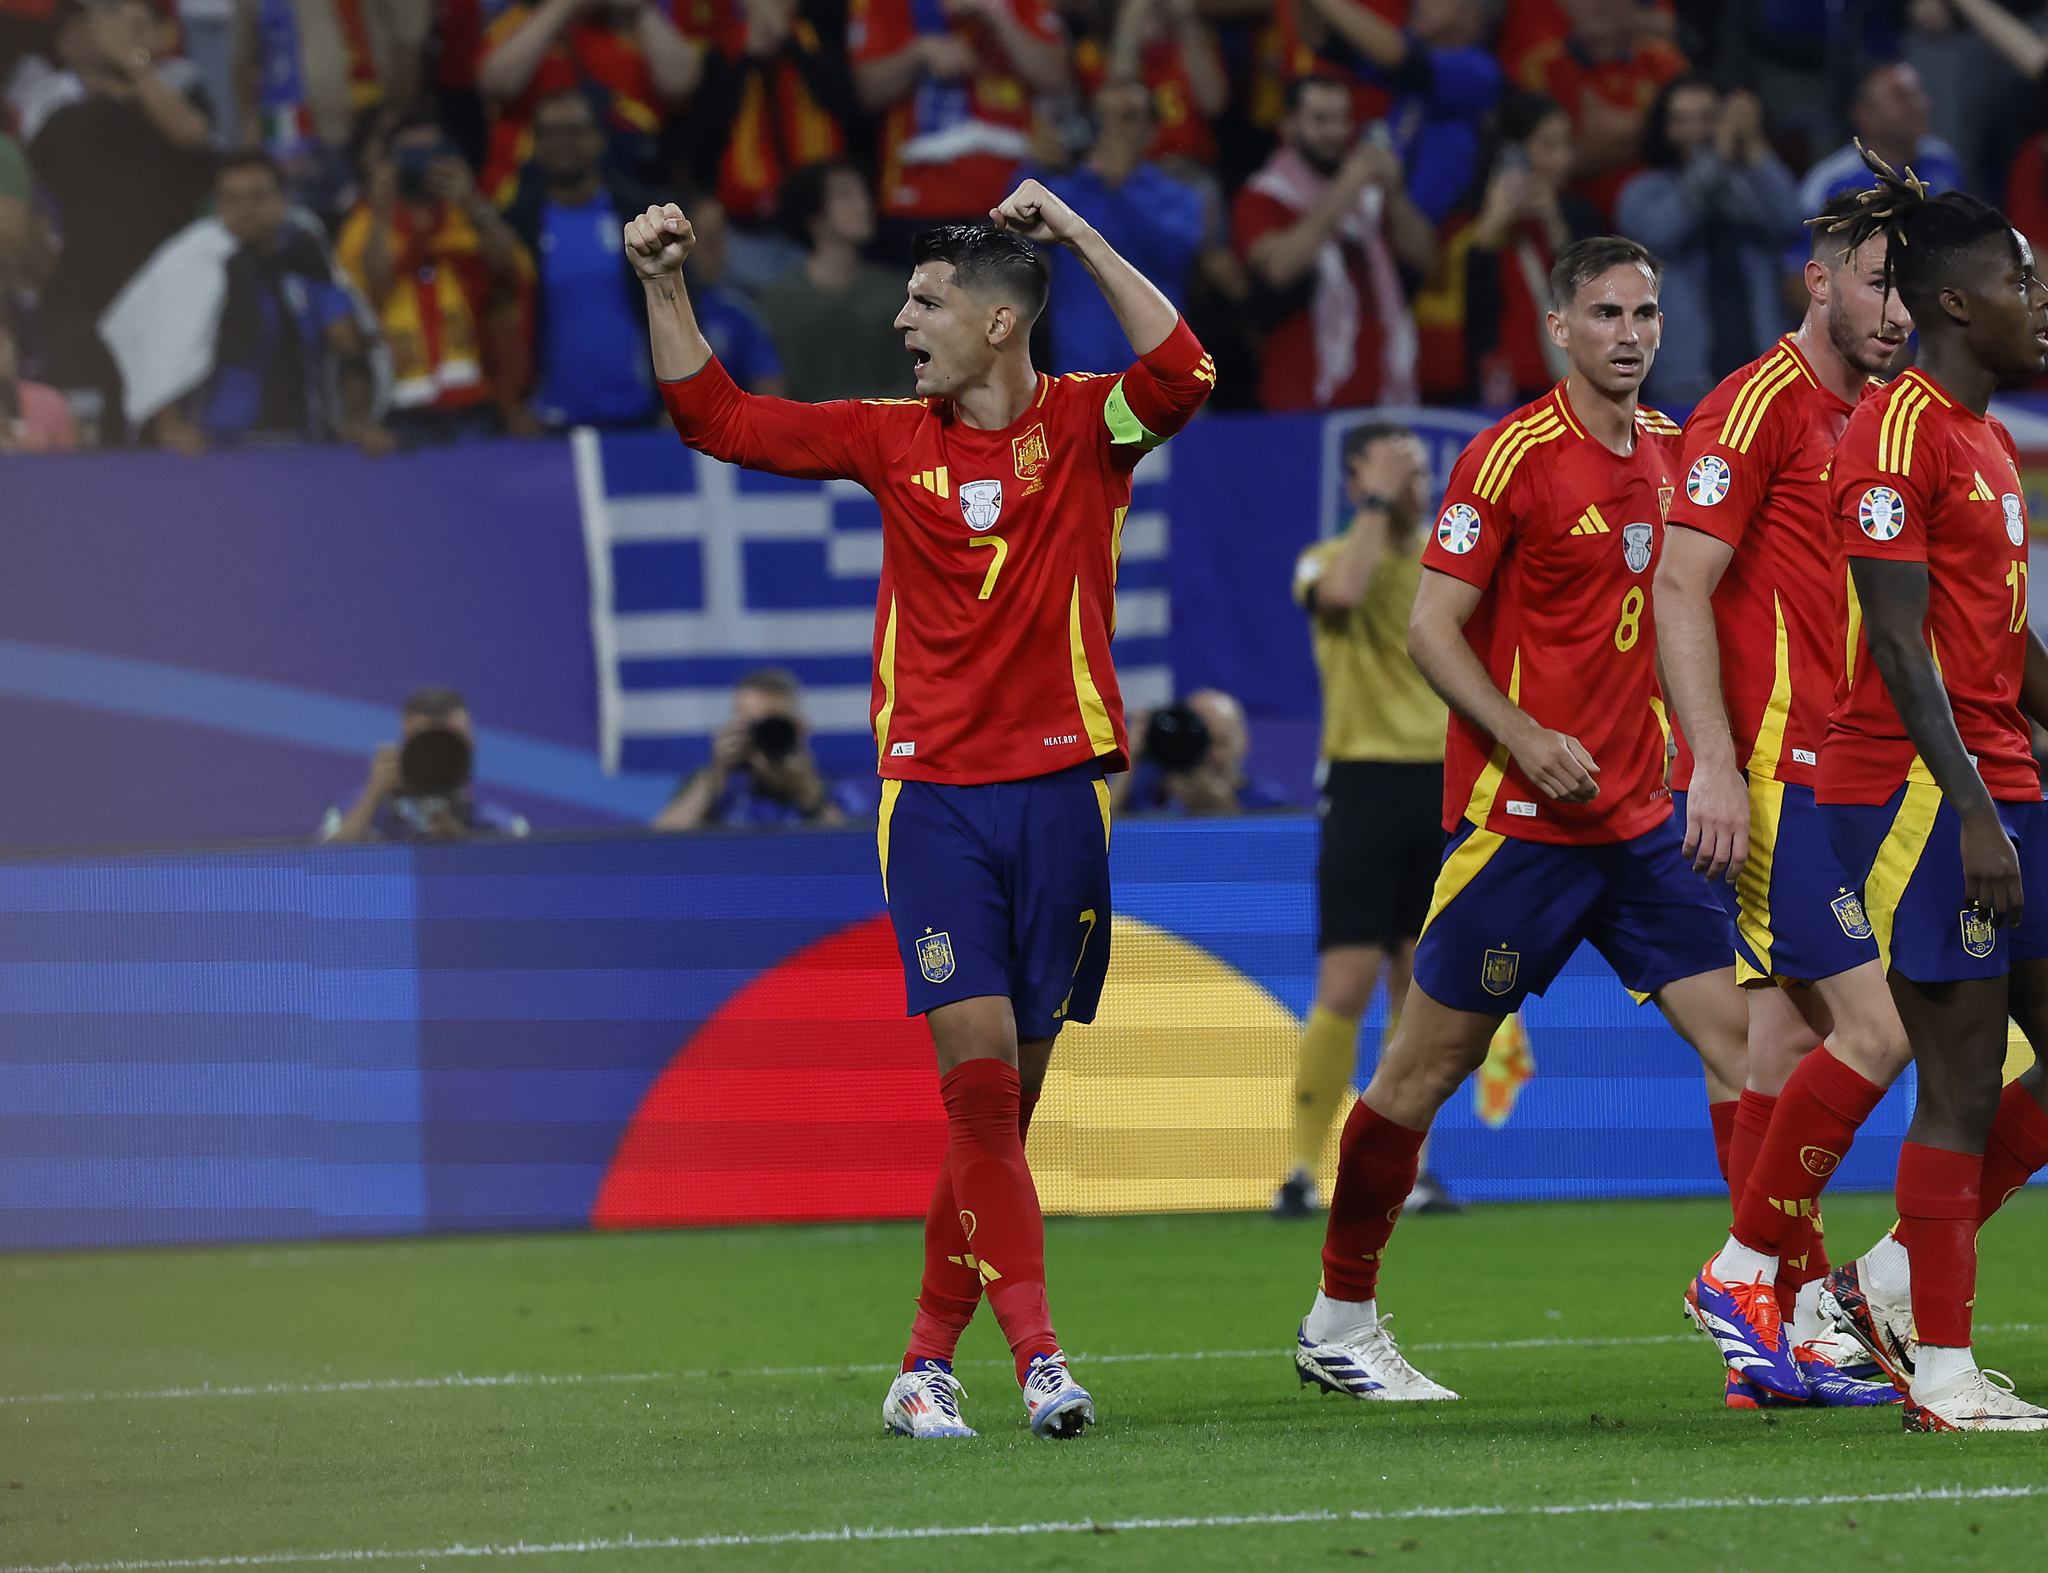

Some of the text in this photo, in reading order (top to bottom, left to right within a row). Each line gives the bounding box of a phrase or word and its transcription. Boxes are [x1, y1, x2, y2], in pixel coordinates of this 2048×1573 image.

[969, 535, 1009, 600] 7
[2005, 560, 2028, 634] 17
[1614, 585, 1645, 653] 8
[1043, 734, 1078, 746] HEAT.RDY
[1072, 908, 1097, 978] 7
